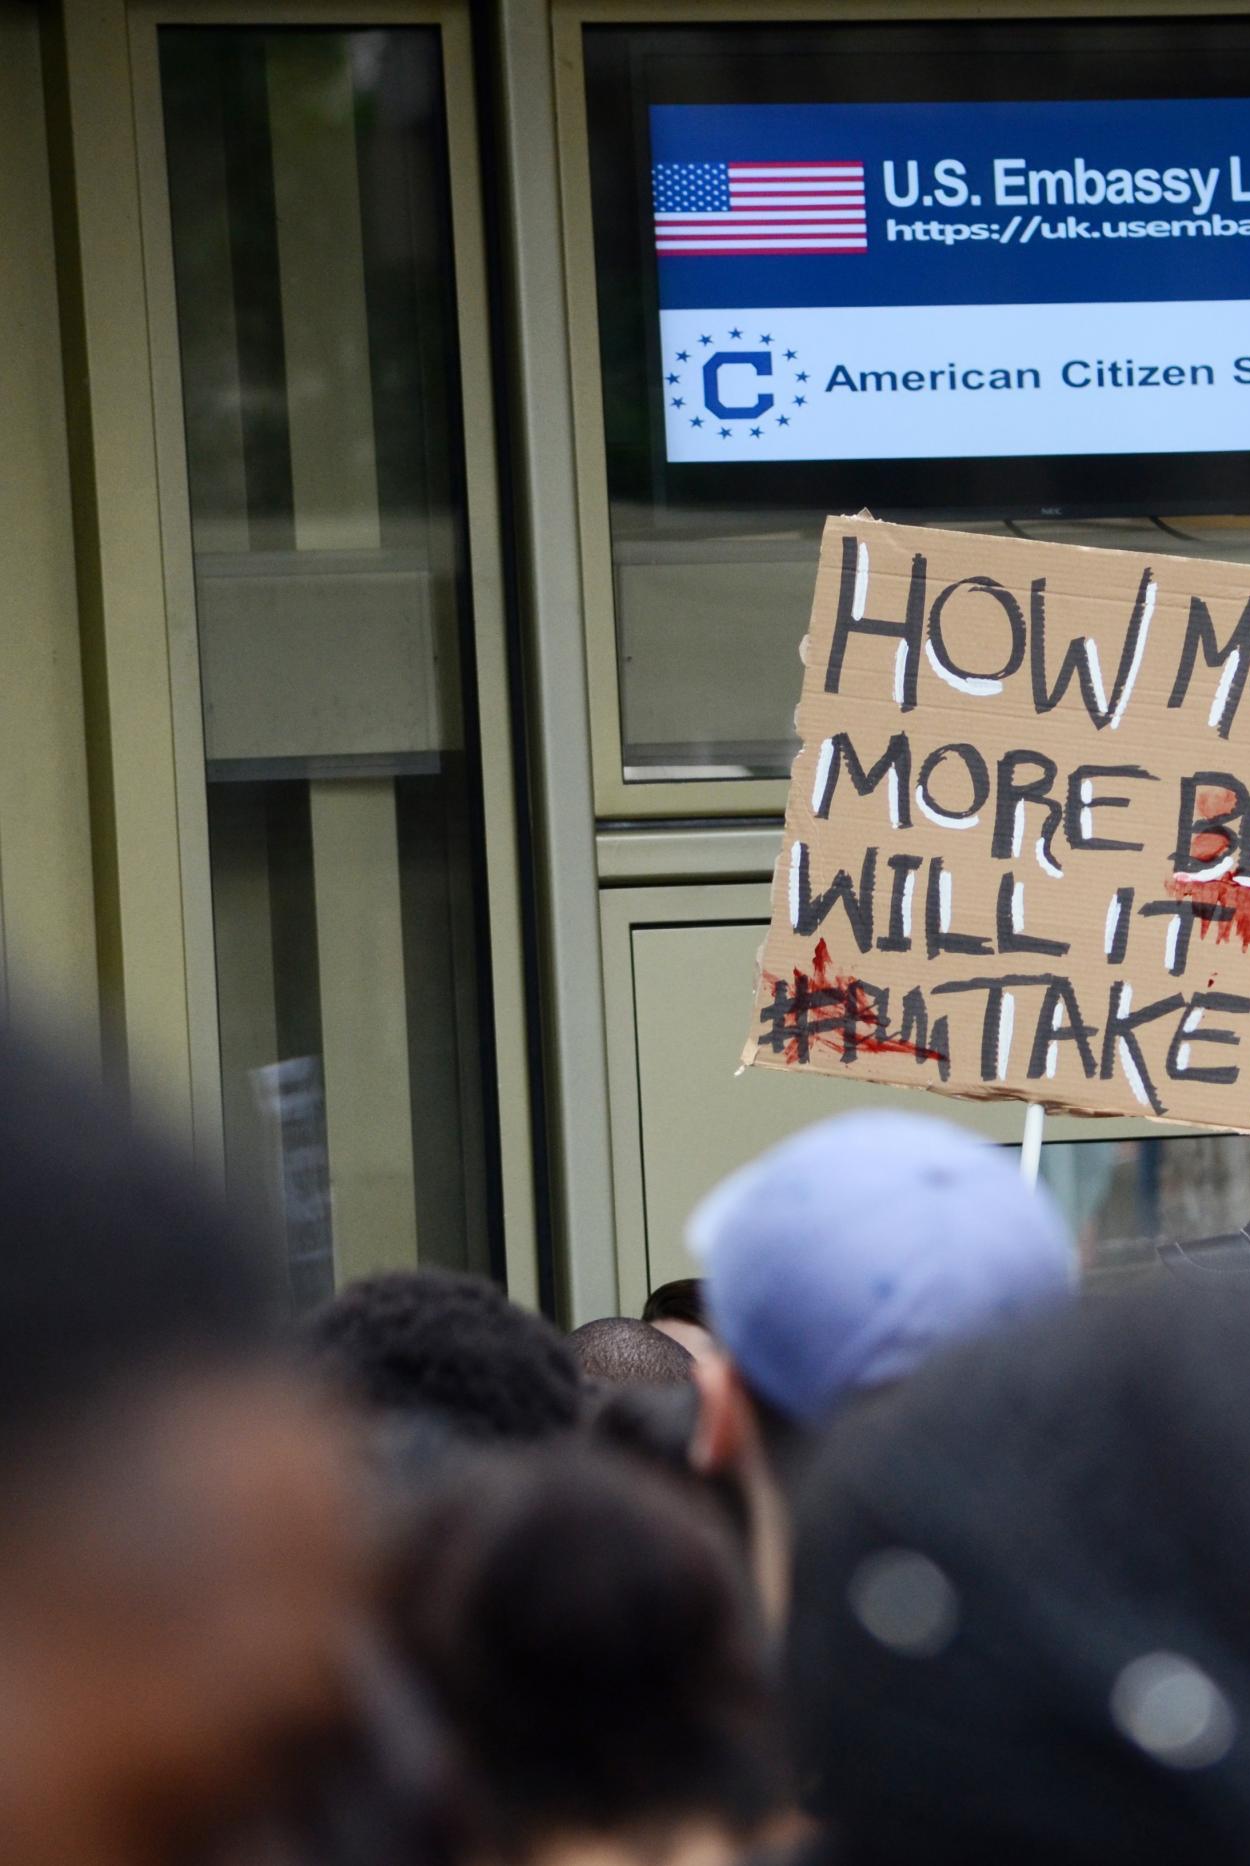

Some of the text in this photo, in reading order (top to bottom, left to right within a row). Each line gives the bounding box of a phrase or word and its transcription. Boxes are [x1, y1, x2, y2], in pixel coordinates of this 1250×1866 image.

[883, 158, 982, 208] U.S.
[994, 157, 1219, 215] Embassy
[825, 360, 1041, 393] American
[1060, 355, 1215, 389] Citizen
[823, 536, 1158, 731] HOW
[811, 730, 1161, 879] MORE
[789, 840, 1238, 977] WILL IT
